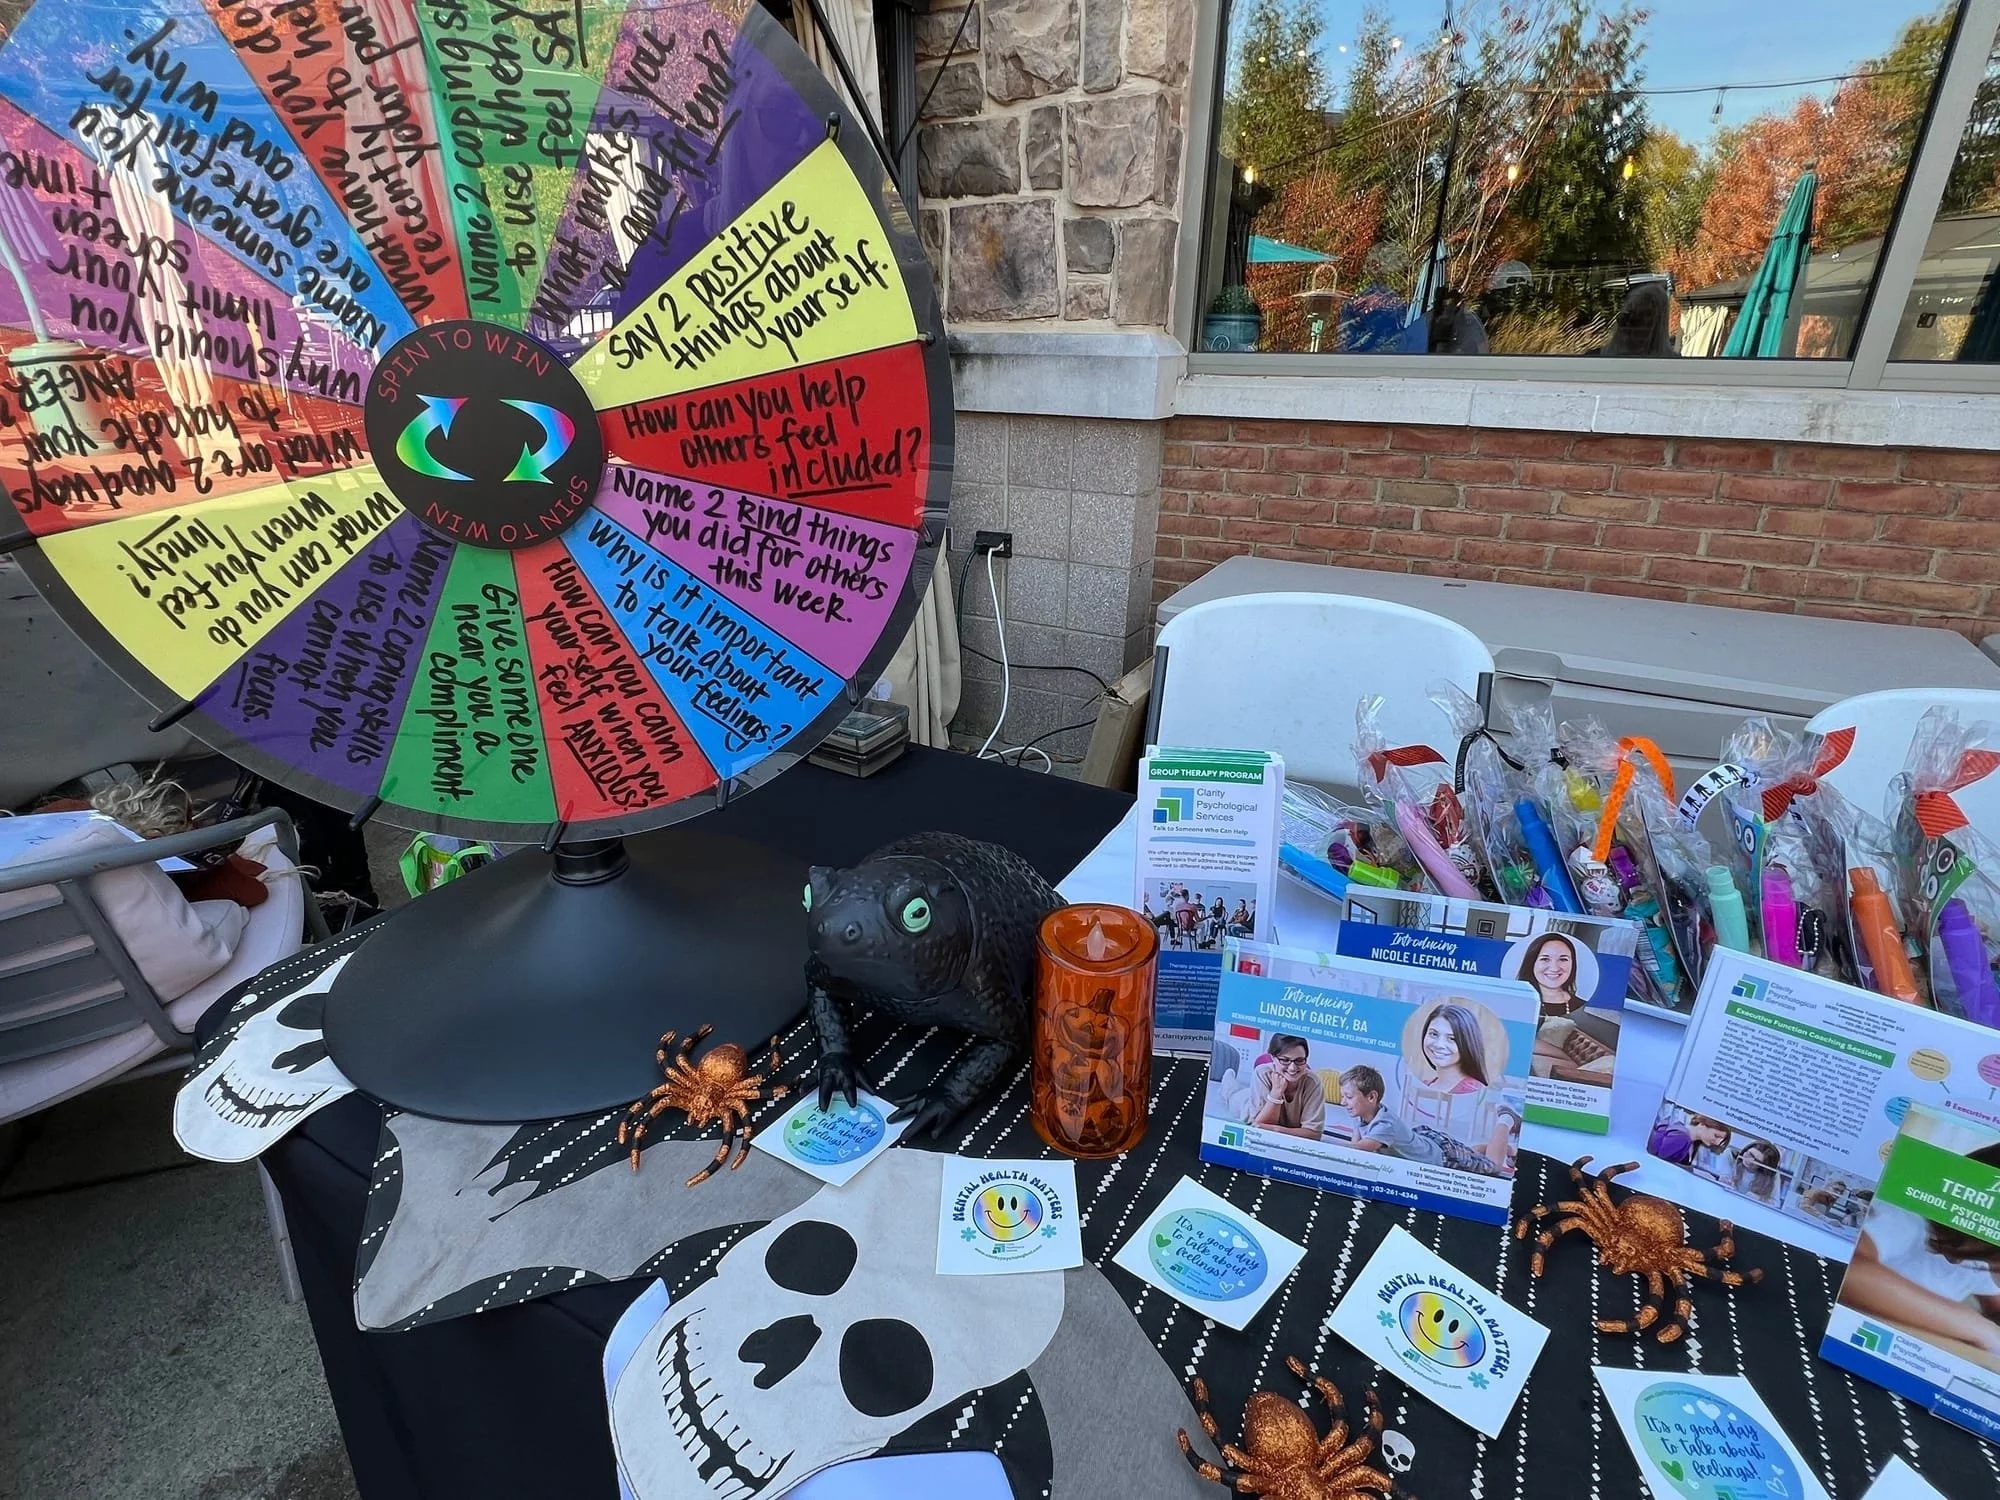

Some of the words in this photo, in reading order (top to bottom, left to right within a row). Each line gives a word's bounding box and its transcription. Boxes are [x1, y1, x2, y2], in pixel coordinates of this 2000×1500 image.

[86, 65, 152, 121] for
[124, 18, 219, 123] why.
[69, 103, 152, 171] you
[217, 116, 294, 181] and
[600, 259, 632, 290] a
[621, 162, 674, 247] good
[653, 29, 752, 179] friend?
[0, 149, 112, 209] time
[155, 112, 322, 248] grateful
[531, 236, 597, 326] What
[617, 29, 685, 122] you
[53, 207, 192, 273] screen
[152, 160, 293, 278] someone
[47, 245, 163, 302] your
[316, 239, 370, 292] are
[608, 313, 672, 369] Say
[658, 291, 692, 335] 2
[686, 200, 810, 312] positive
[69, 292, 145, 344] you
[178, 279, 276, 341] limit
[298, 265, 386, 348] Name
[674, 293, 768, 371] things
[764, 228, 842, 303] about
[766, 238, 889, 363] yourself.
[154, 320, 279, 378] should
[378, 341, 432, 402] SPIN
[429, 328, 473, 351] TO
[484, 330, 550, 377] WIN
[621, 402, 678, 439] How
[685, 393, 734, 432] can
[735, 386, 793, 440] you
[799, 368, 866, 426] help
[680, 430, 770, 468] others
[776, 412, 837, 463] feel
[767, 426, 922, 494] included?
[251, 491, 336, 552] when
[328, 491, 401, 556] What
[425, 501, 489, 543] WIN
[539, 475, 589, 532] SPIN
[613, 466, 696, 512] Name
[703, 489, 727, 519] 2
[806, 513, 895, 574] things
[117, 517, 226, 599] lonely?
[207, 524, 266, 588] you
[279, 539, 332, 588] can
[368, 551, 402, 575] to
[500, 525, 539, 543] TO
[643, 508, 690, 543] you
[698, 520, 750, 558] did
[755, 531, 805, 574] for
[805, 555, 889, 601] others
[235, 567, 291, 624] you
[398, 529, 455, 609] Name
[708, 555, 763, 594] this
[157, 570, 220, 630] feel
[349, 579, 386, 625] use
[392, 607, 427, 630] 2
[481, 582, 519, 652] Give
[586, 517, 647, 571] Why
[642, 560, 670, 591] is
[671, 574, 705, 610] it
[699, 598, 827, 702] important
[207, 613, 249, 648] do
[288, 599, 344, 692] cannot
[451, 603, 486, 668] near
[612, 578, 640, 614] to
[697, 647, 771, 703] about
[243, 652, 289, 723] focus.
[352, 628, 415, 705] coping
[539, 664, 587, 714] feel
[541, 556, 593, 610] How
[574, 606, 621, 656] can
[599, 654, 649, 700] you
[634, 700, 686, 765] calm
[461, 675, 495, 723] you
[525, 601, 614, 699] yourself
[597, 700, 648, 771] when
[627, 762, 670, 802] you
[639, 633, 705, 686] your
[694, 678, 793, 752] feelings?
[299, 697, 347, 752] you
[347, 702, 392, 766] skills
[415, 651, 474, 802] compliment.
[472, 732, 501, 757] a
[560, 718, 650, 812] ANXIOUS?
[1150, 768, 1180, 776] GROUP
[1181, 768, 1217, 777] THERAPY
[1219, 770, 1262, 780] PROGRAM
[1196, 788, 1226, 799] Clarity
[1195, 812, 1234, 822] Services
[1196, 801, 1258, 814] Psychological
[1233, 828, 1249, 836] Help
[1371, 947, 1410, 964] NICOLE
[1411, 952, 1459, 971] LEFMAN,
[1461, 958, 1478, 973] MA
[1390, 931, 1459, 955] Introducing
[1259, 1001, 1306, 1021] LINDSAY
[1309, 1011, 1349, 1031] GAREY,
[1352, 1019, 1368, 1033] BA
[1281, 986, 1354, 1015] Introducing
[1736, 1007, 1772, 1024] Executive
[1773, 1019, 1808, 1036] Function
[1808, 1030, 1847, 1050] Coaching
[1846, 1043, 1883, 1061] Sessions
[952, 1181, 980, 1222] MENTAL
[979, 1169, 1029, 1185] HEALTH
[1029, 1177, 1063, 1220] MATTERS
[1905, 1186, 1948, 1210] SCHOOL
[1942, 1178, 1995, 1210] TERRI
[1171, 1228, 1185, 1240] to
[1185, 1236, 1211, 1257] talk
[1211, 1252, 1248, 1278] about
[1174, 1214, 1193, 1232] It's
[1196, 1229, 1205, 1240] a
[1206, 1236, 1235, 1258] good
[1236, 1250, 1261, 1271] day
[1174, 1246, 1229, 1280] feelings!
[1376, 1272, 1426, 1305] MENTAL
[1428, 1274, 1487, 1316] HEALTH
[1483, 1317, 1511, 1380] MATTERS
[1641, 1414, 1671, 1434] It's
[1674, 1423, 1687, 1436] a
[1689, 1420, 1726, 1439] good
[1727, 1420, 1758, 1441] day
[1660, 1436, 1679, 1455] to
[1679, 1436, 1716, 1456] talk
[1718, 1442, 1766, 1460] about
[1692, 1459, 1761, 1483] feelings!
